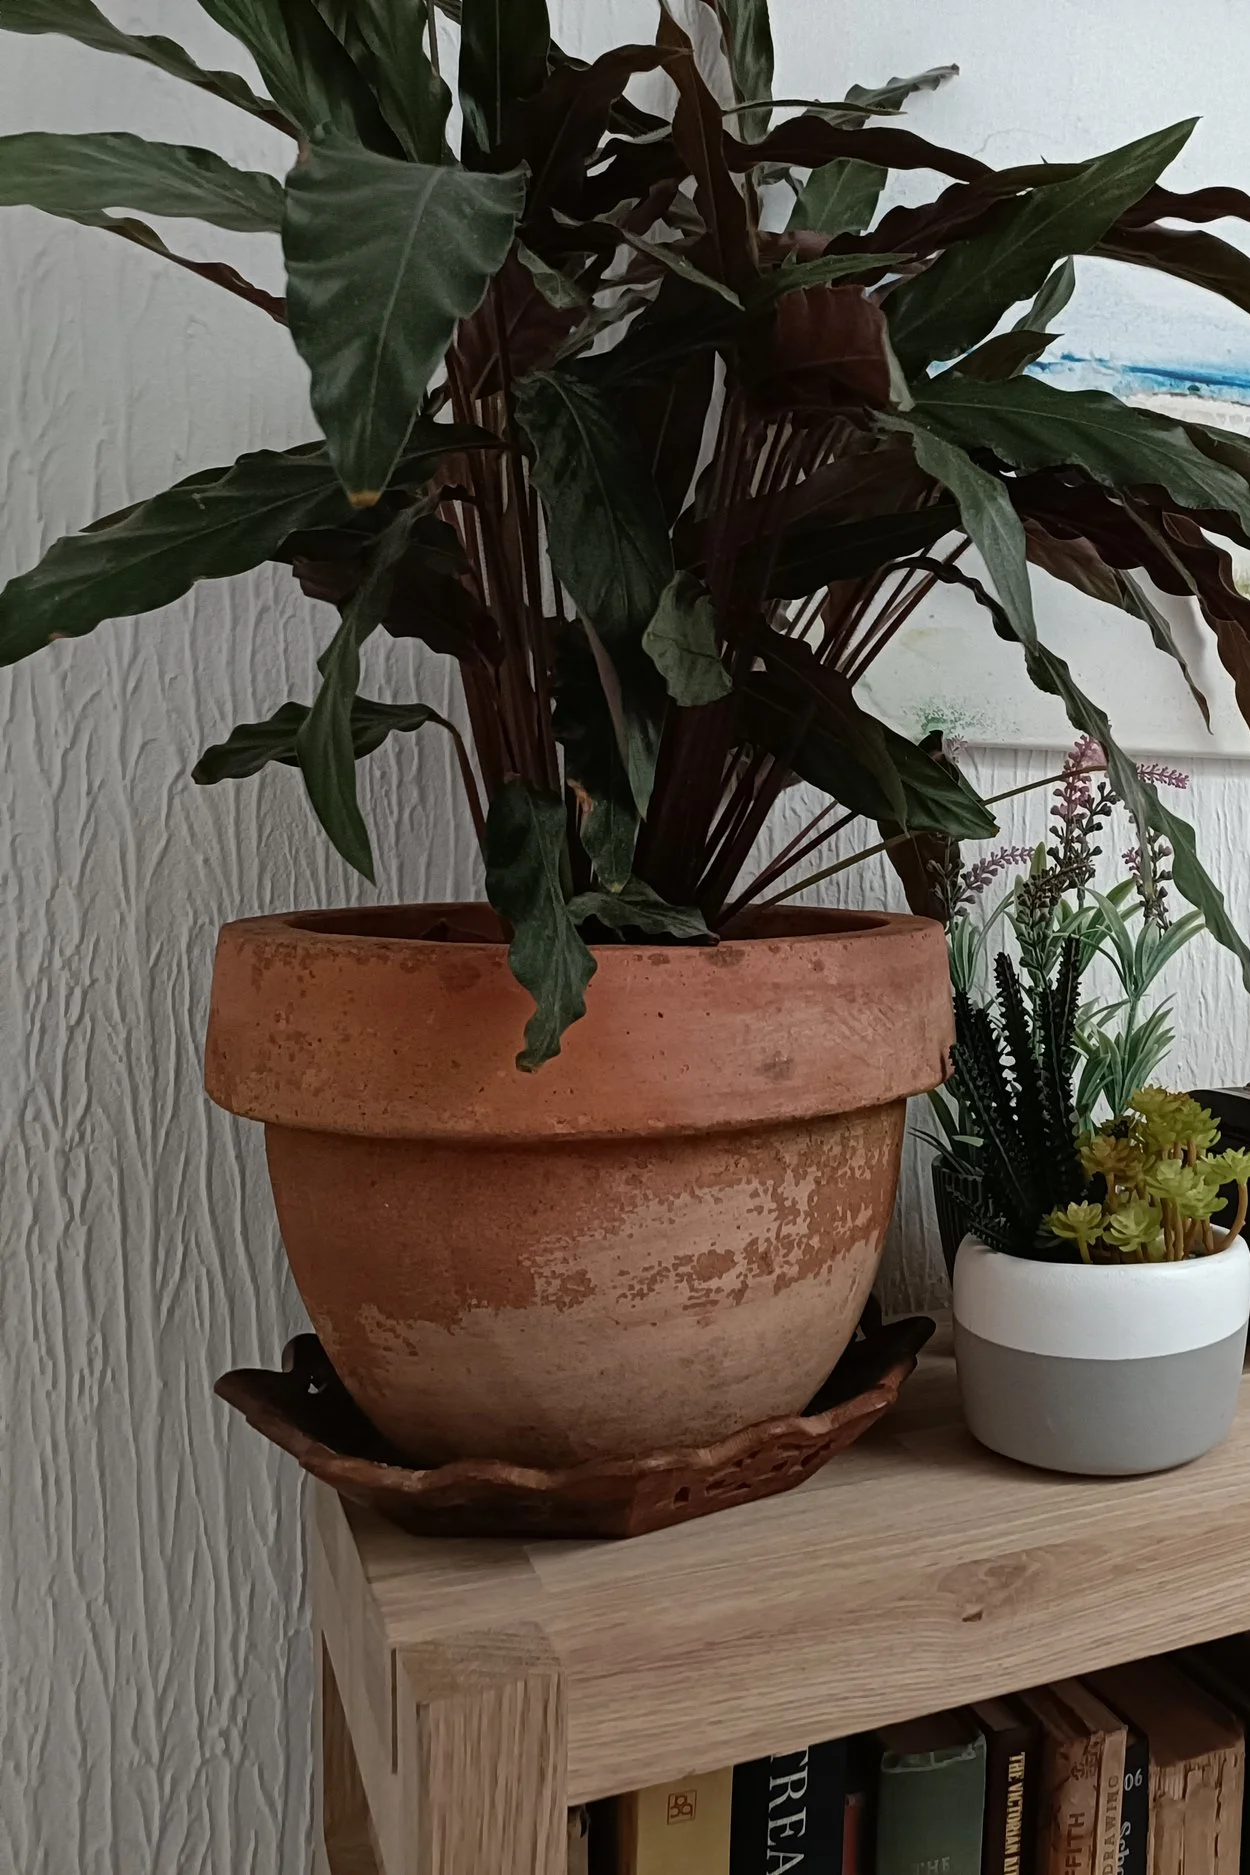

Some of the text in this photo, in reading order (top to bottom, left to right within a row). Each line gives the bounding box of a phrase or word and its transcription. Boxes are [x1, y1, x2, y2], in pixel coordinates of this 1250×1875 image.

[1007, 1752, 1025, 1782] THE
[1005, 1781, 1023, 1855] VICTORIAN
[1102, 1776, 1120, 1875] DRAWING
